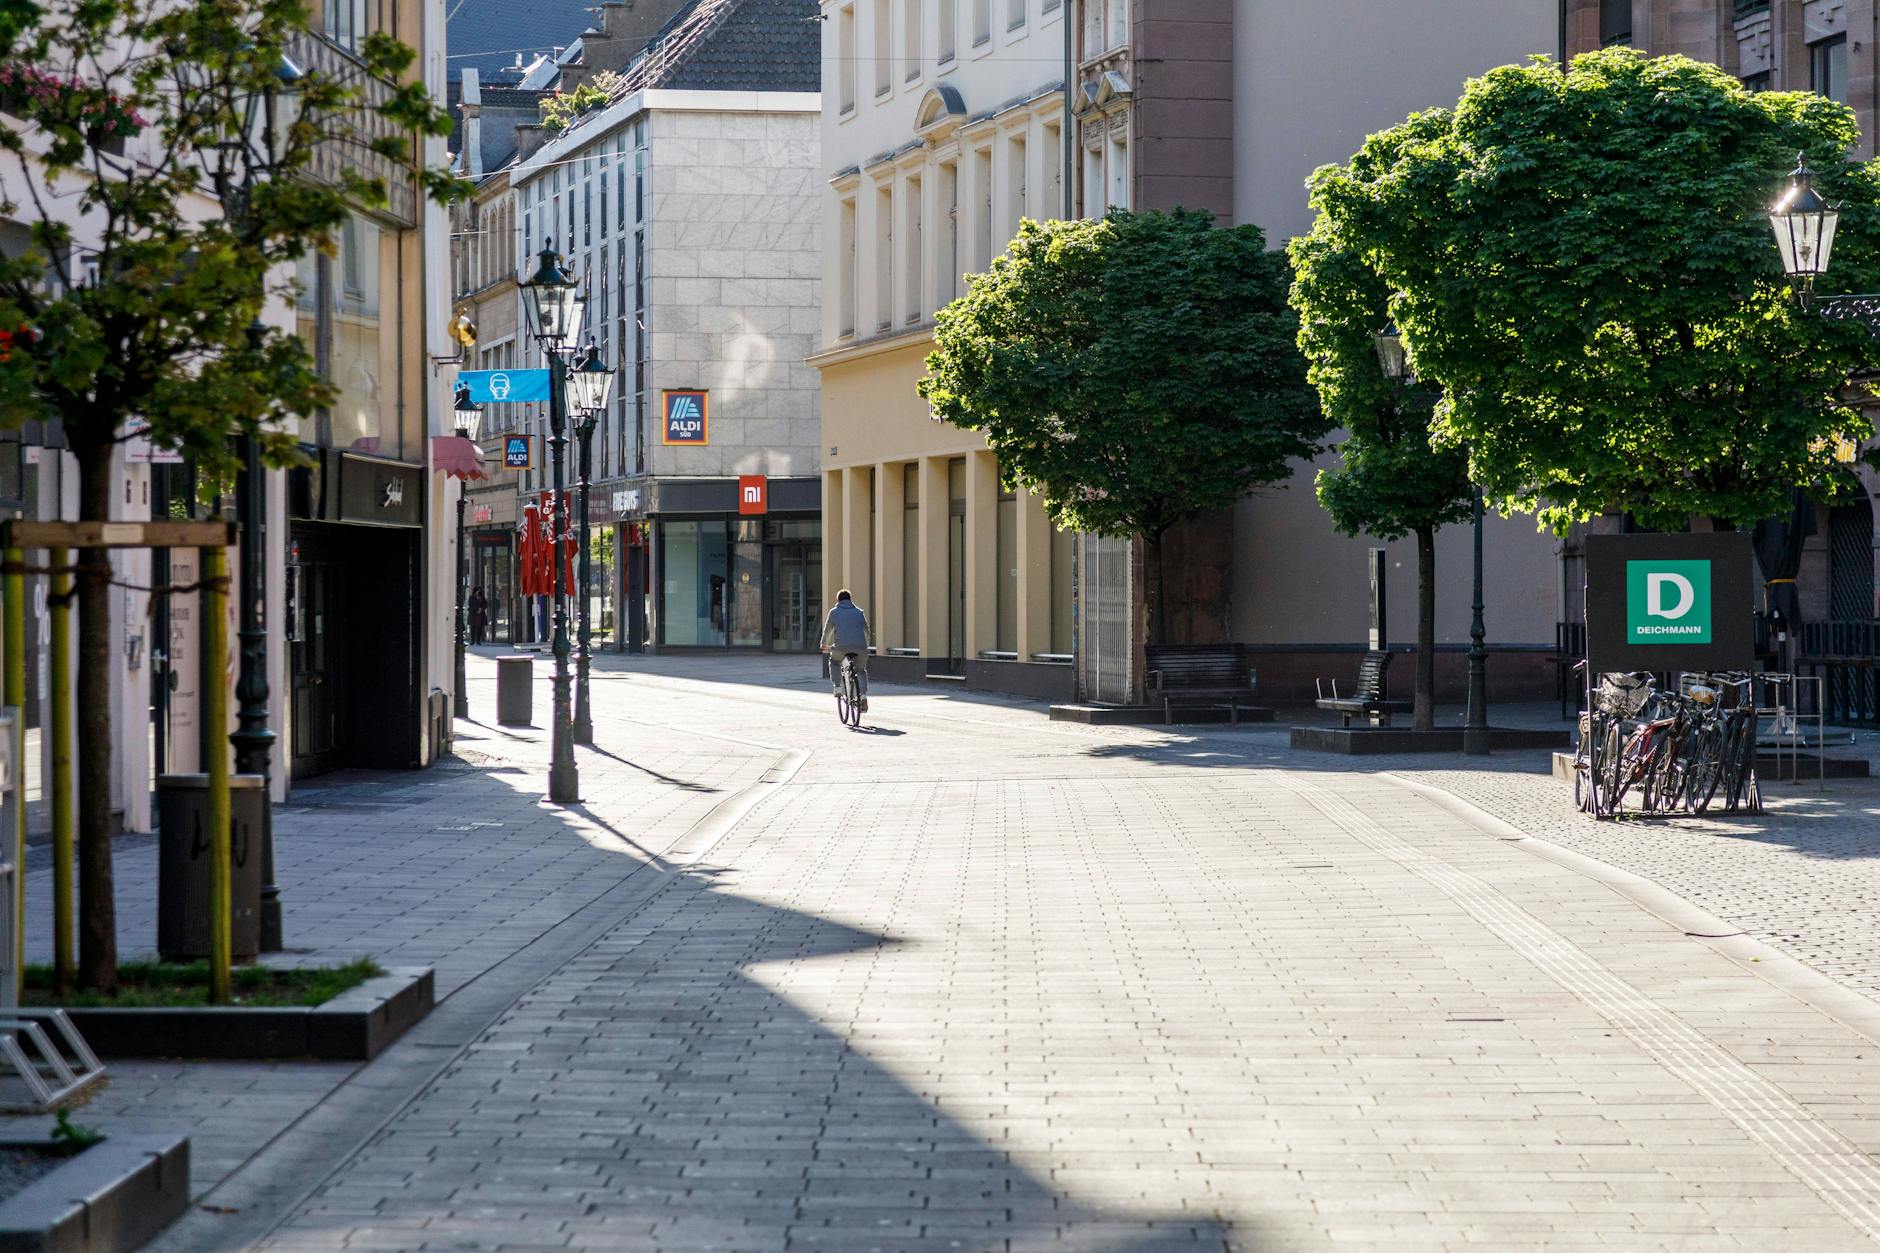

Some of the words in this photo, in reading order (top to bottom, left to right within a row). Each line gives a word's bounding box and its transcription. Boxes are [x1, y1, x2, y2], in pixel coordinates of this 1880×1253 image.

[670, 421, 701, 431] ALDI
[1647, 572, 1695, 620] D
[1637, 626, 1702, 634] DEICHMANN
